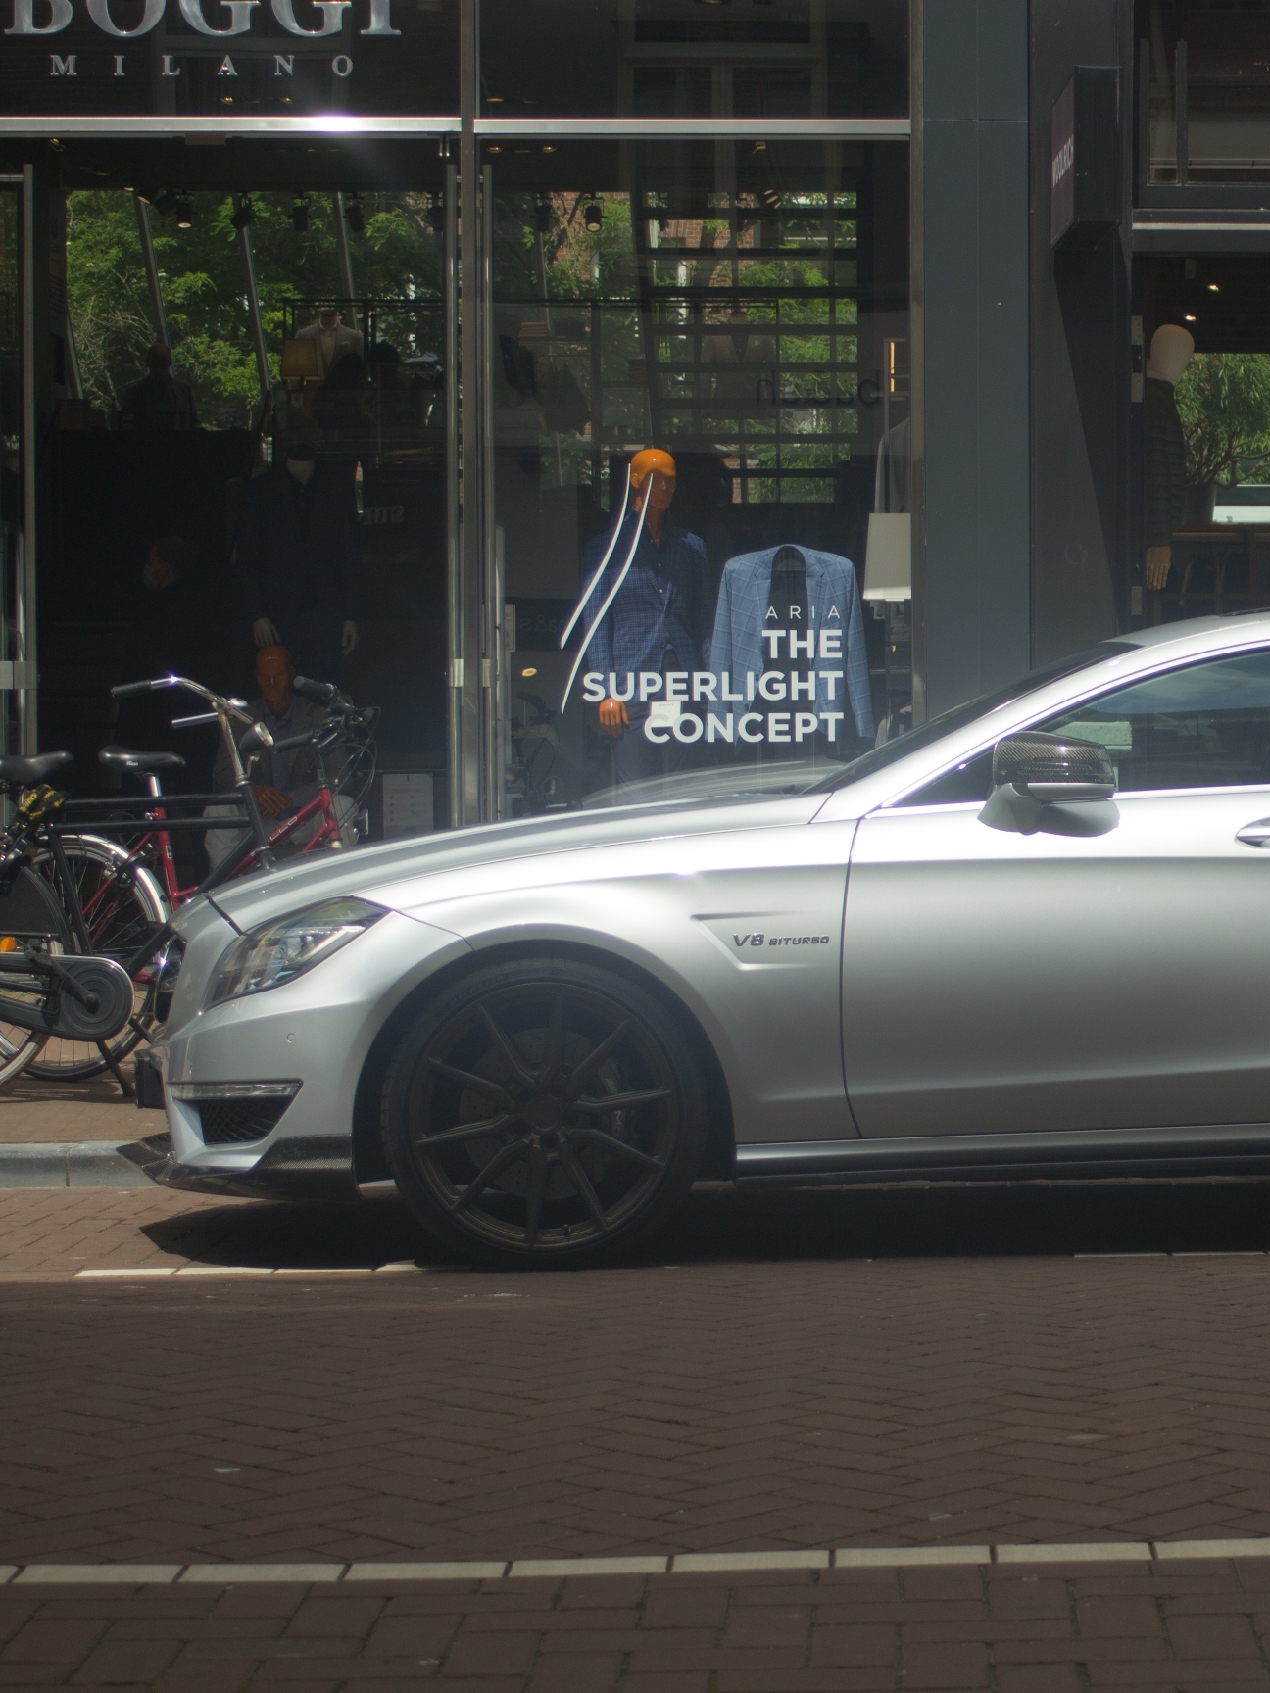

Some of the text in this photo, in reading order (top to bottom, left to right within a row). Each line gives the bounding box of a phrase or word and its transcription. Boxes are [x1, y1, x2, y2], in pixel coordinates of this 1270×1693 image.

[50, 55, 354, 77] MILANO
[765, 604, 841, 619] ARIA
[761, 629, 843, 659] THE
[582, 670, 844, 702] SUPERLIGHT
[644, 711, 844, 744] CONCEPT
[733, 933, 830, 946] V8 BITURBO
